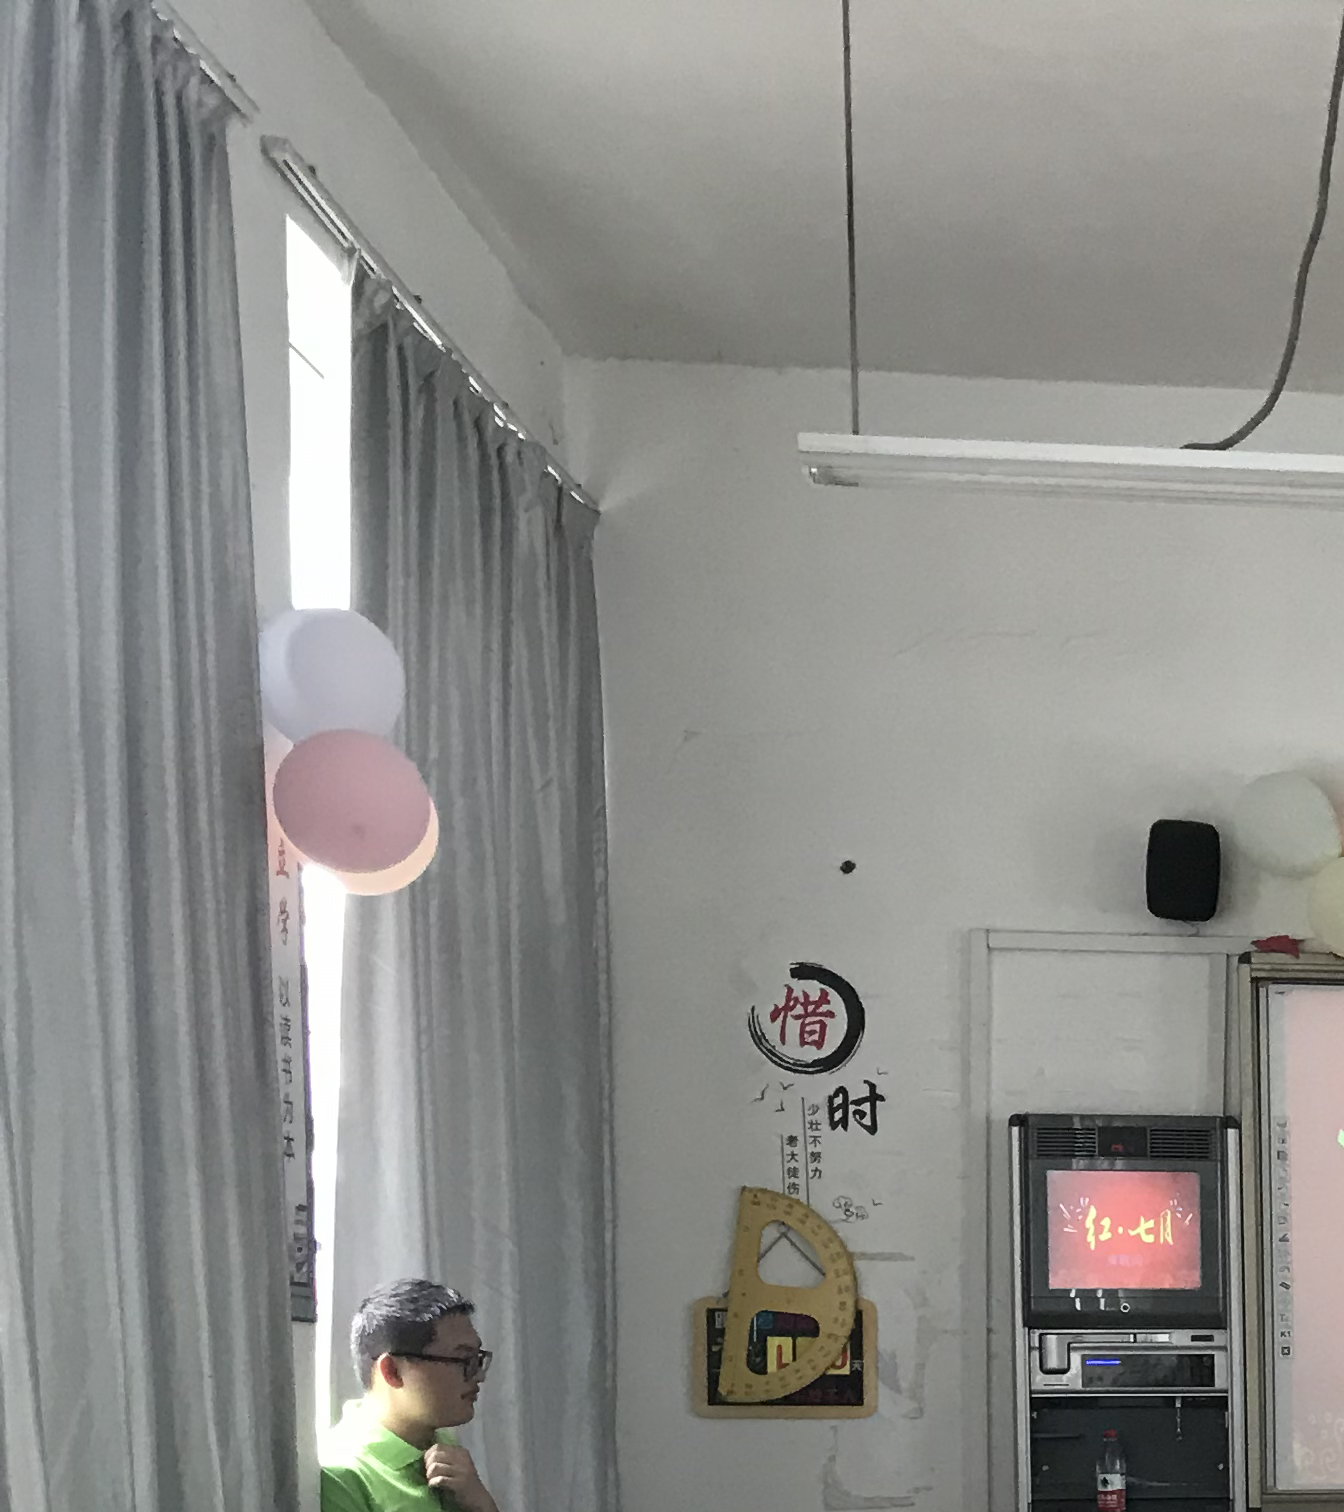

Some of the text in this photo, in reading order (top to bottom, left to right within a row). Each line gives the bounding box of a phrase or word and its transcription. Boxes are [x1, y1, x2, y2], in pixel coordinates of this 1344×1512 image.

[769, 983, 836, 1051] 惜
[806, 1103, 823, 1180] 少壮不努力
[828, 1079, 887, 1137] 时
